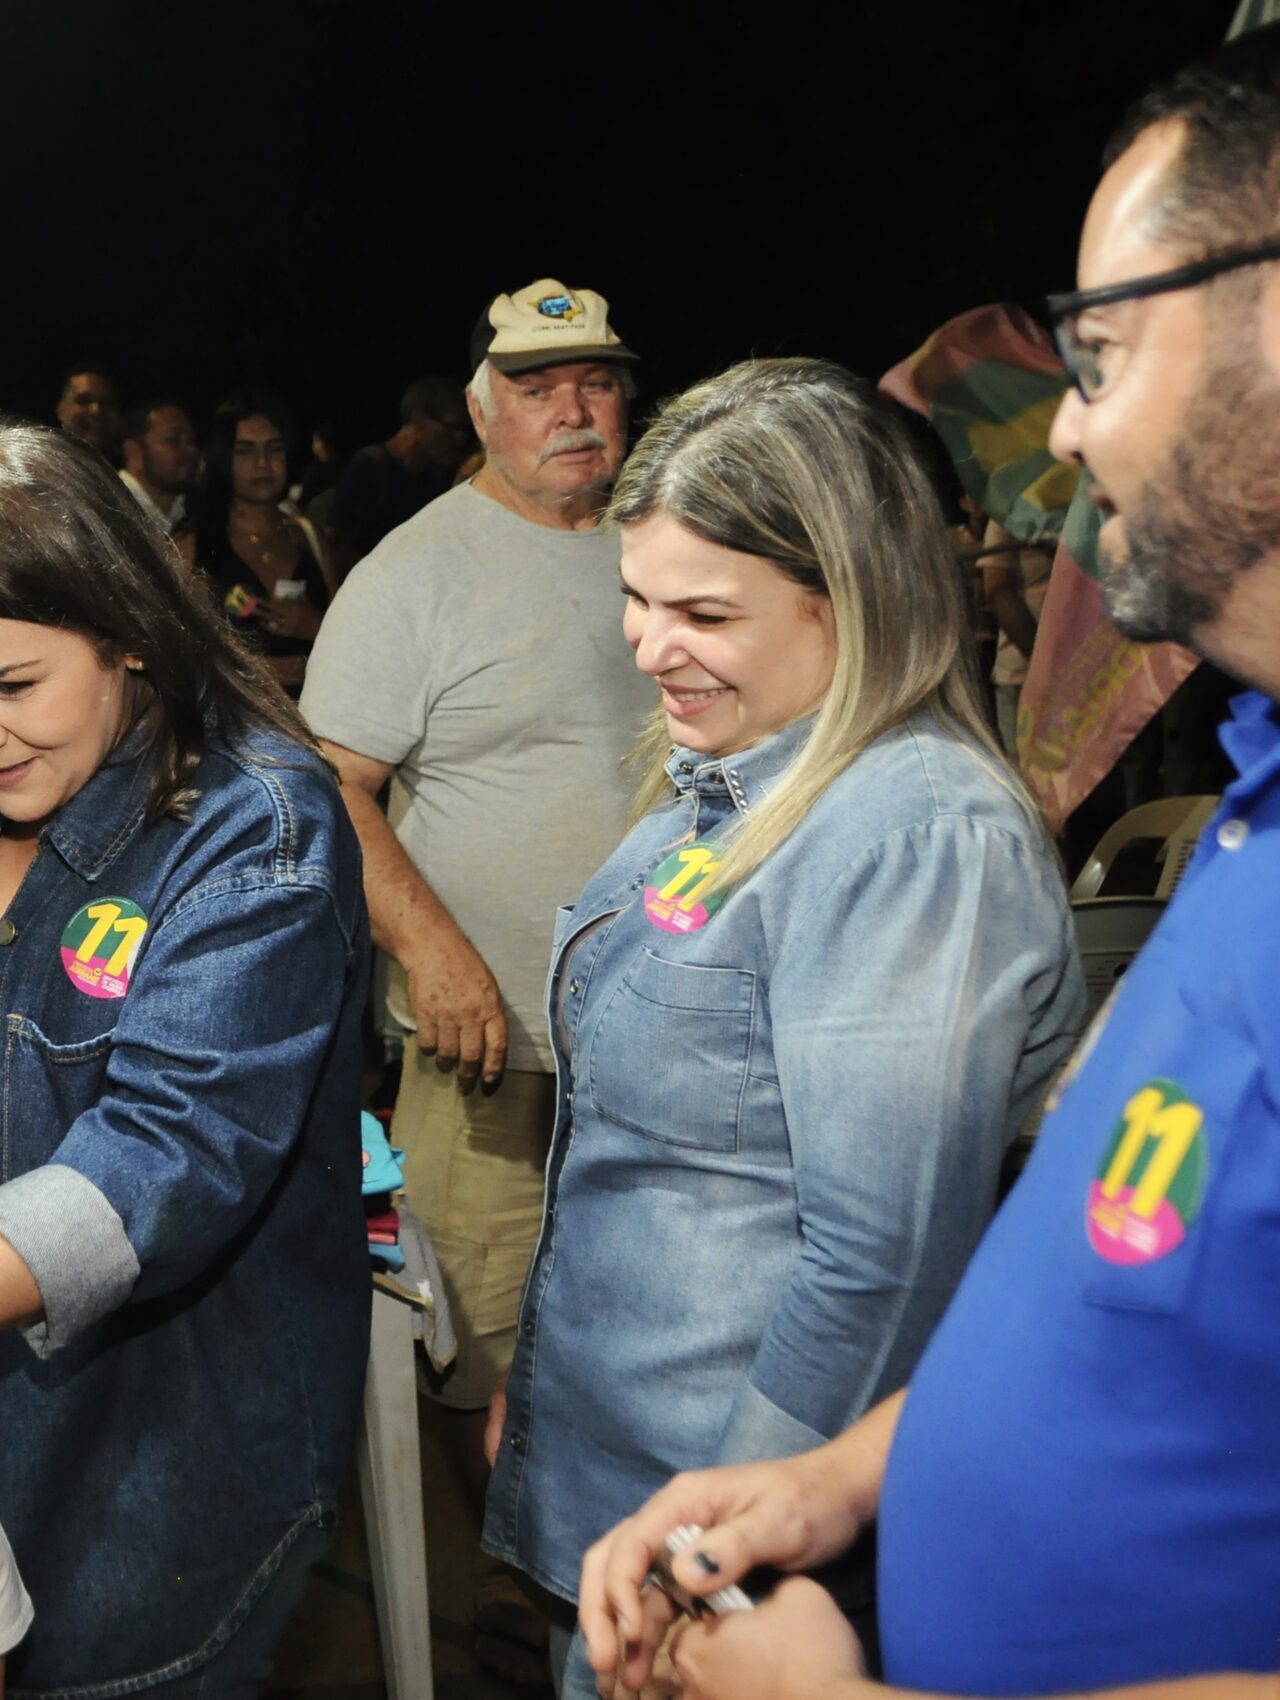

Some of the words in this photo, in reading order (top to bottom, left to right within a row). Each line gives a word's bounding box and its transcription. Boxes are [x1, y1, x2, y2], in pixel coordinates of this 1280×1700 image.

[658, 848, 724, 912] 11
[75, 903, 149, 977] 11
[1101, 1087, 1204, 1220] 11
